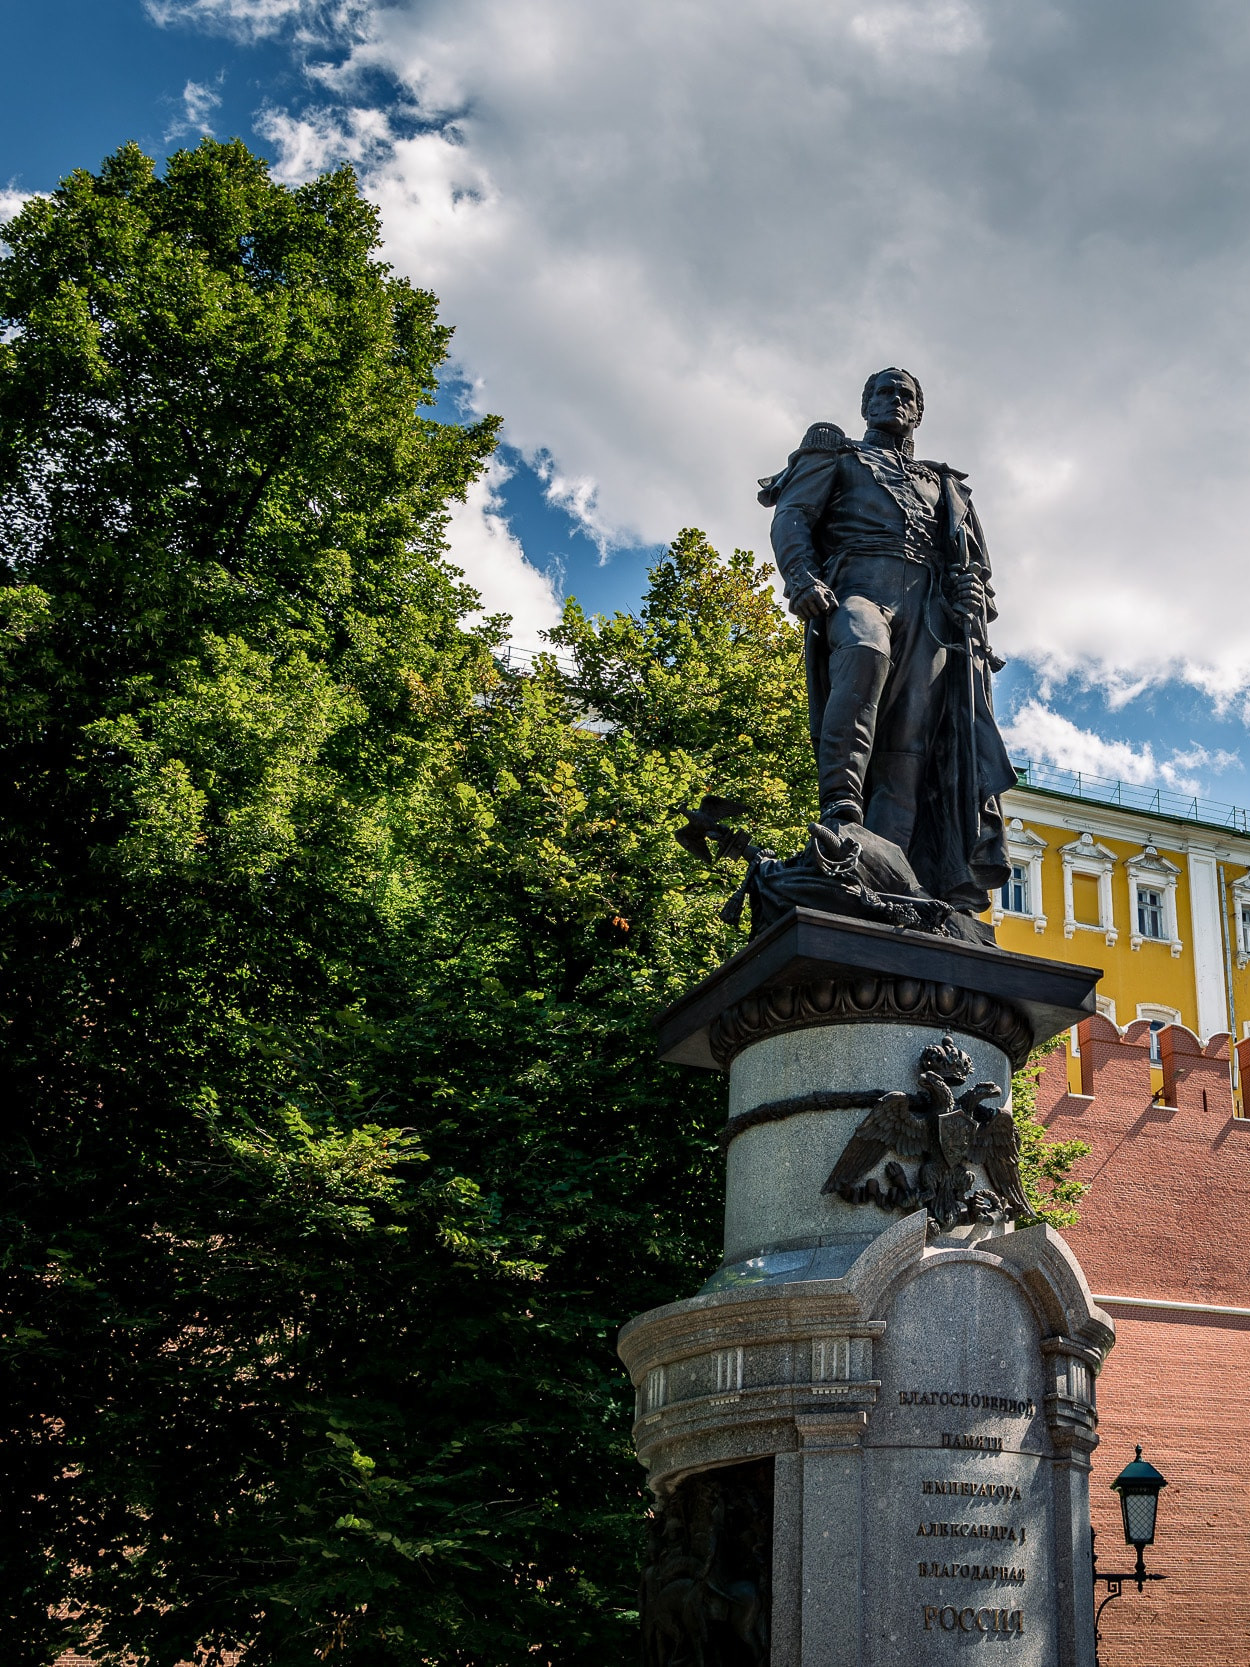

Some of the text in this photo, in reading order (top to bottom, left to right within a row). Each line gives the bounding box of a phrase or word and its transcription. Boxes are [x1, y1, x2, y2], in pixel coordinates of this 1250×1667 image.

[899, 1391, 1033, 1416] БЛАГОСЛОВЕННОЙ
[942, 1433, 1004, 1450] ПАМЯТИ
[922, 1480, 1022, 1500] ИМПЕРАТОРА
[916, 1522, 1017, 1541] АЛЕКСАНДРА
[918, 1562, 1026, 1581] БЛАГОДАРНАЯ
[922, 1604, 1025, 1633] РОССИЯ
